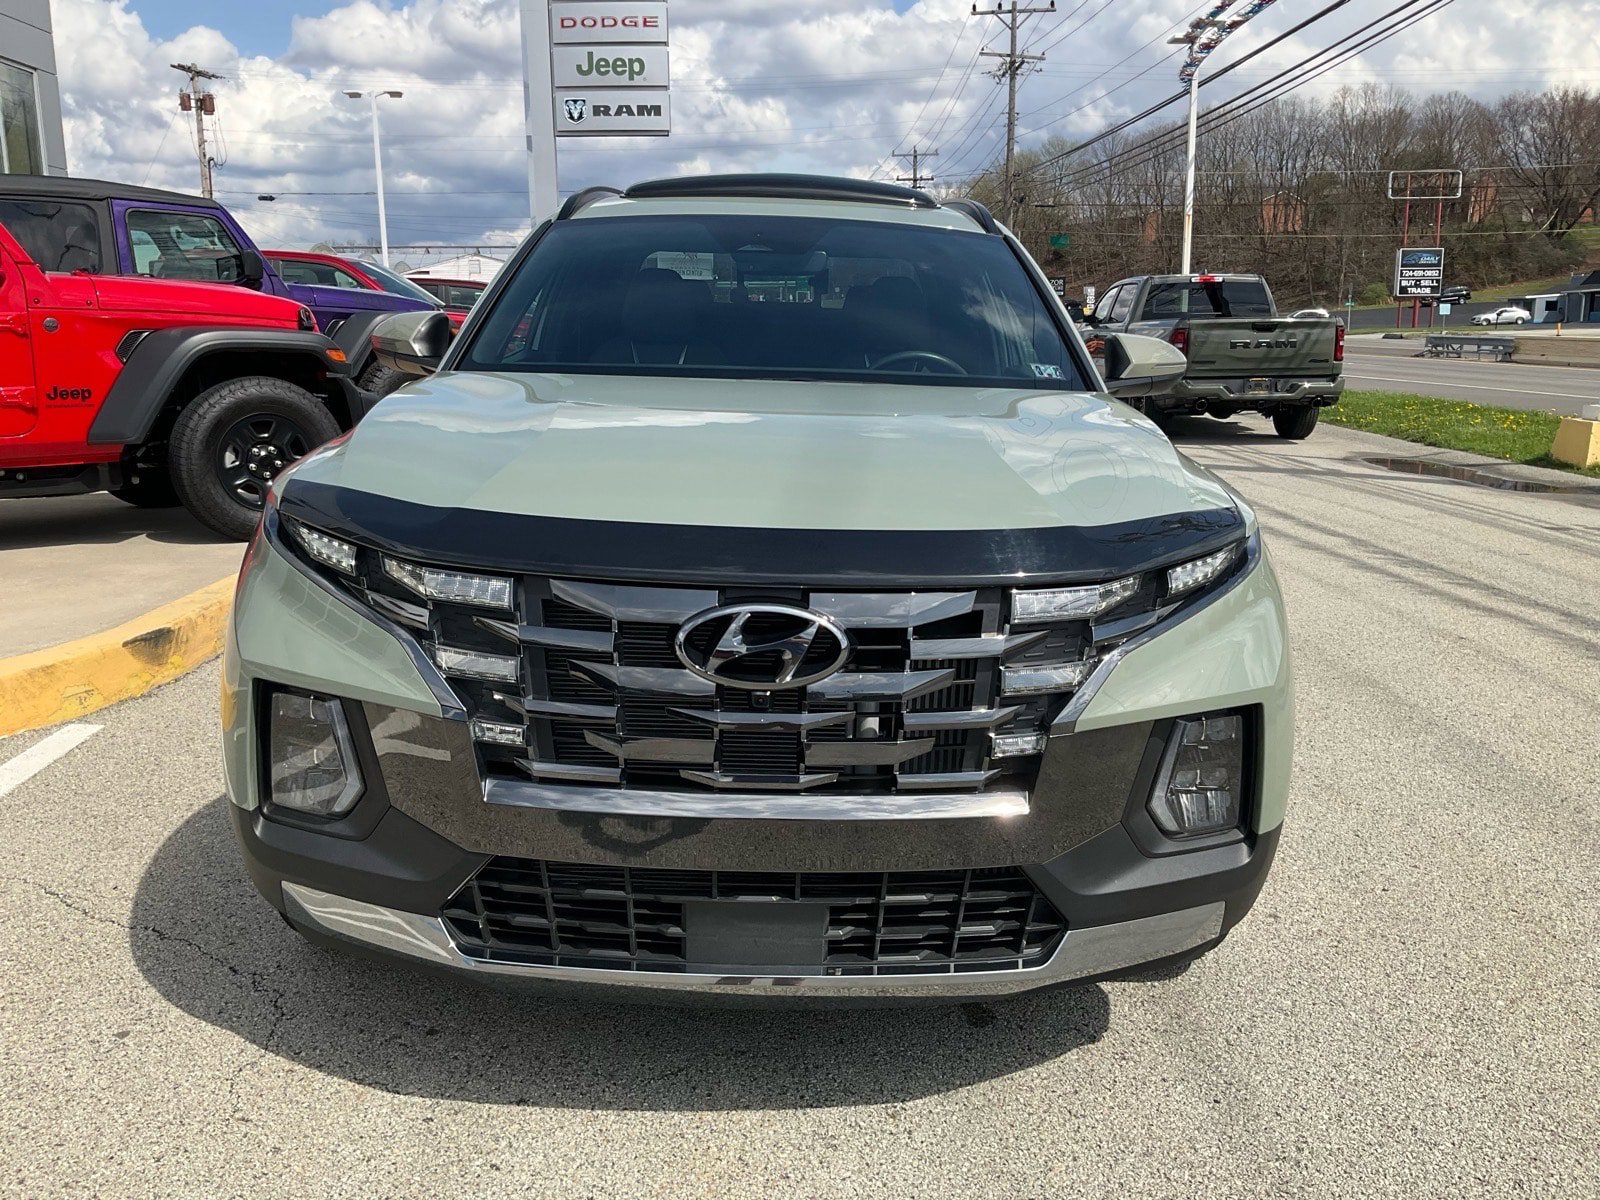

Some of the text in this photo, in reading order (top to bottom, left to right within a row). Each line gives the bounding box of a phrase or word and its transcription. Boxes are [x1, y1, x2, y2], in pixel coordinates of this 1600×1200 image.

[560, 16, 659, 28] DODGE
[576, 51, 645, 81] Jeep
[592, 104, 661, 117] RAM
[1230, 339, 1297, 349] RAM
[46, 385, 92, 402] Jeep
